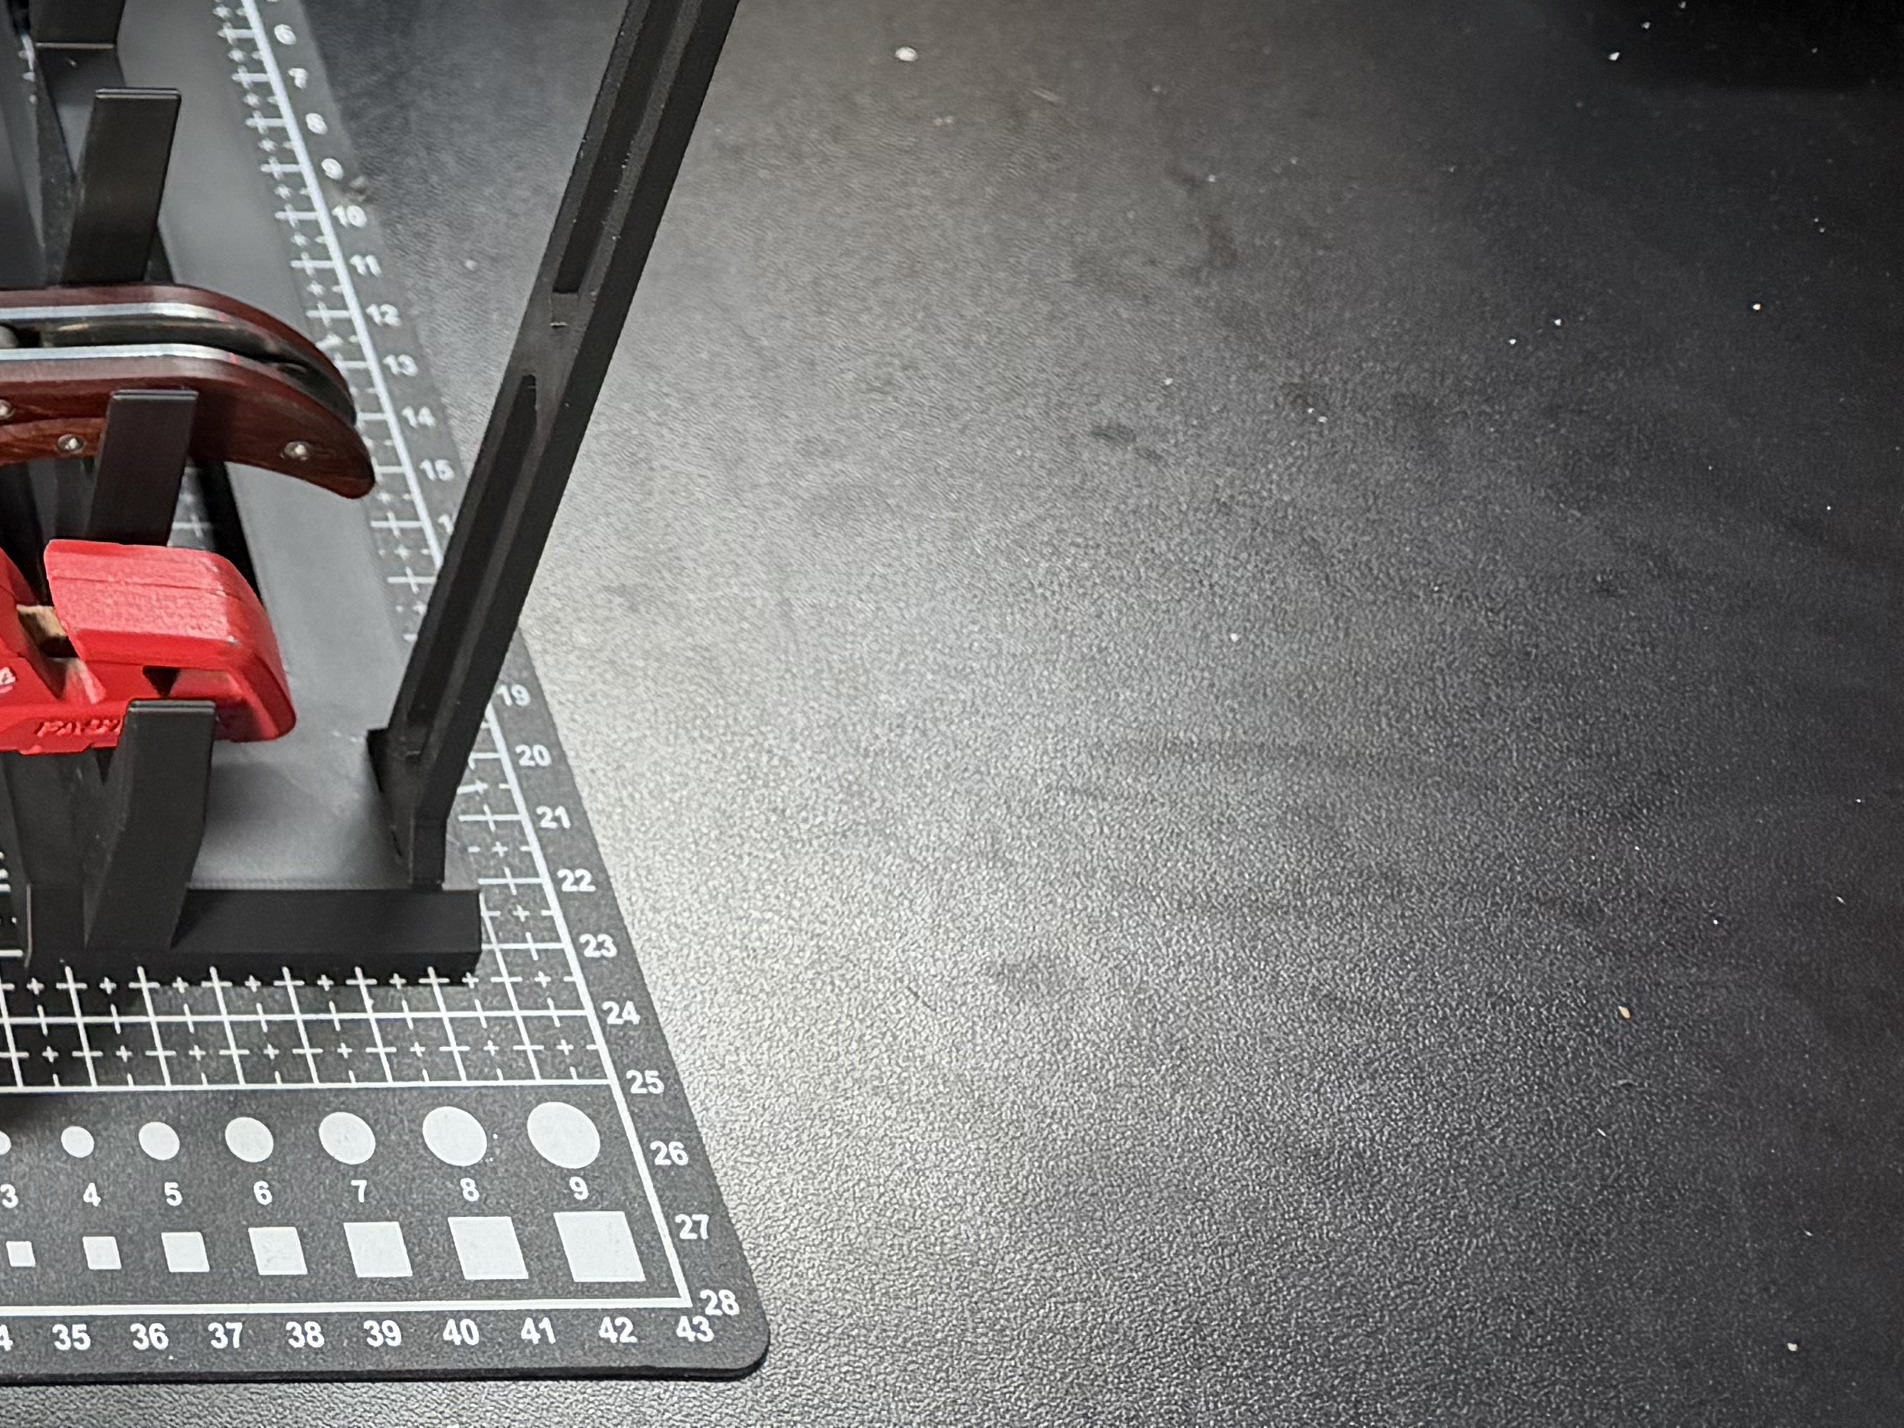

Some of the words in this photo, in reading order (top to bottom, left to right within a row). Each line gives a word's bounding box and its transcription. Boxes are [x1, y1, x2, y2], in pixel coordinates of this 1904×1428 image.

[331, 204, 368, 228] 10
[349, 254, 382, 276] 11
[365, 303, 401, 327] 12
[382, 354, 418, 377] 13
[401, 406, 436, 428] 14
[419, 459, 455, 481] 15
[496, 683, 532, 707] 19
[515, 743, 552, 769] 20
[534, 804, 572, 832] 21
[555, 867, 597, 894] 22
[577, 932, 618, 959] 23
[600, 999, 642, 1026] 24
[625, 1068, 665, 1096] 25
[649, 1139, 690, 1167] 26
[0, 1182, 20, 1210] 3
[82, 1182, 102, 1208] 4
[163, 1181, 184, 1207] 5
[253, 1179, 273, 1206] 6
[350, 1179, 370, 1204] 7
[459, 1176, 481, 1204] 8
[568, 1175, 590, 1202] 9
[674, 1213, 710, 1241] 27
[698, 1288, 741, 1317] 28
[51, 1323, 92, 1351] 35
[129, 1322, 170, 1351] 36
[207, 1321, 244, 1350] 37
[285, 1320, 326, 1350] 38
[362, 1319, 404, 1348] 39
[442, 1317, 481, 1346] 40
[519, 1316, 557, 1346] 41
[597, 1315, 639, 1346] 42
[675, 1314, 716, 1343] 43
